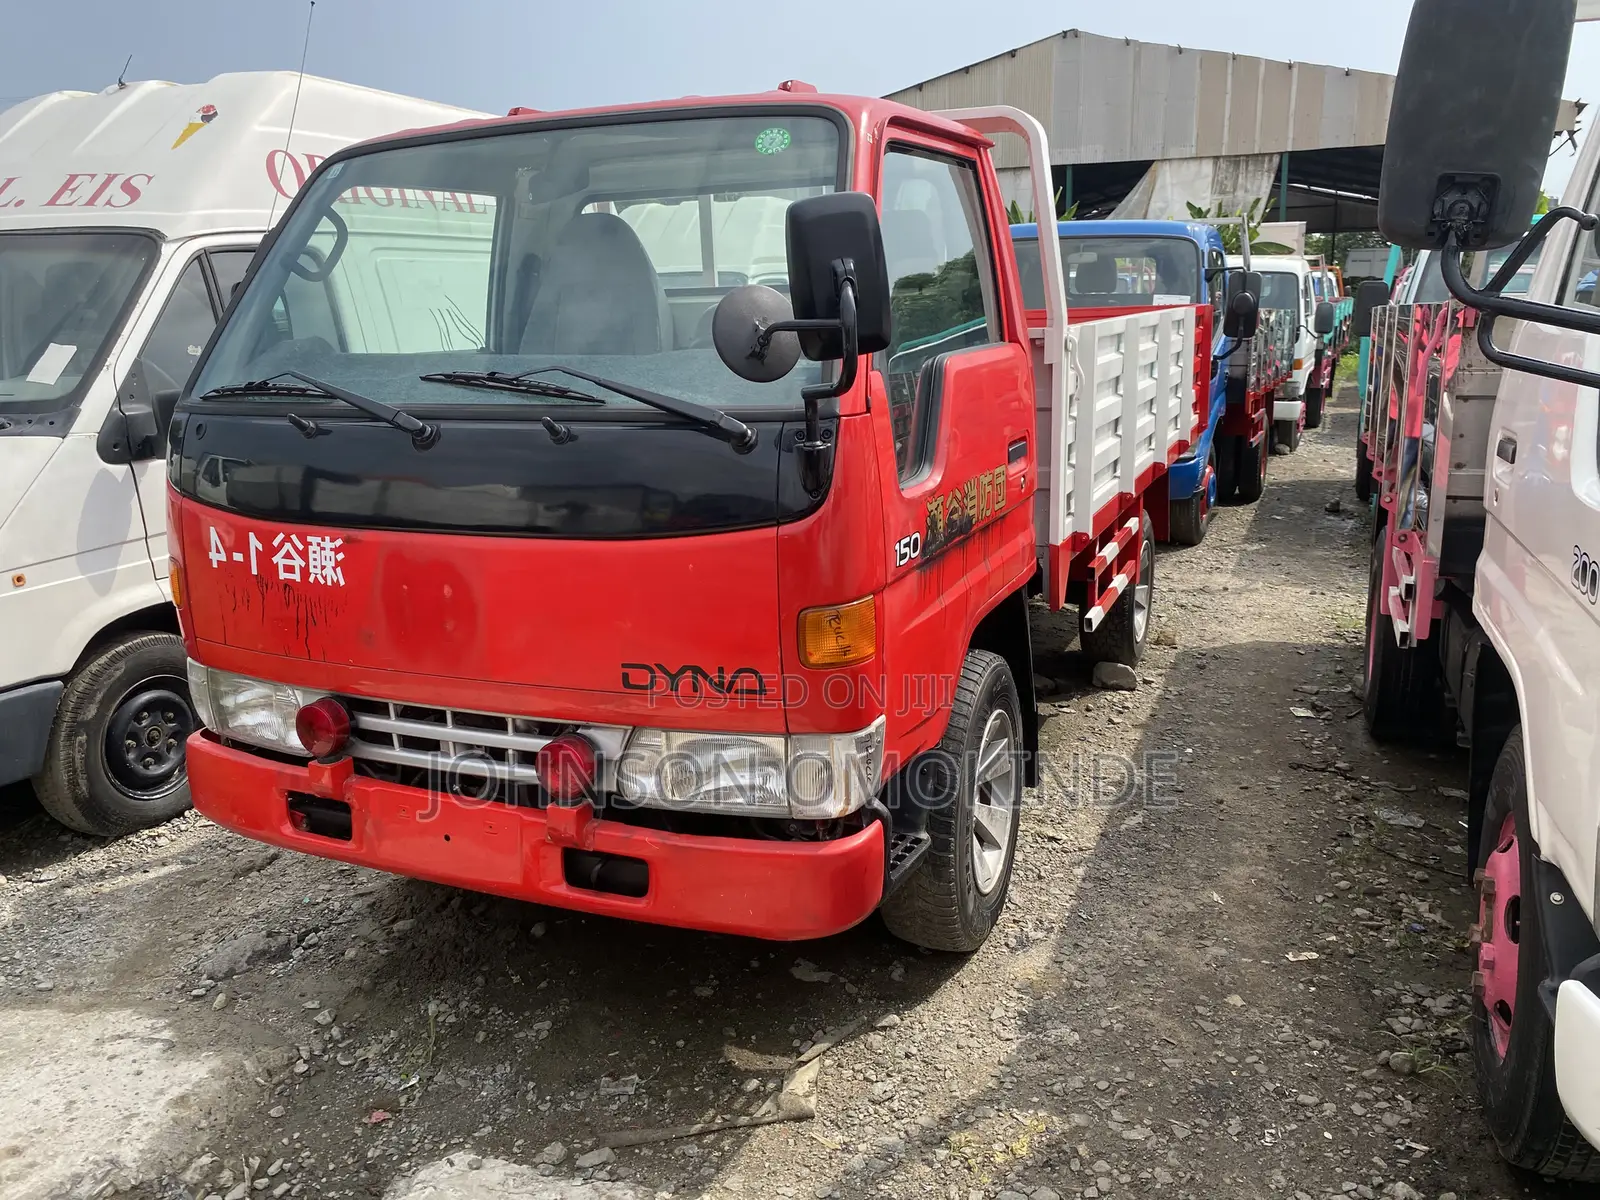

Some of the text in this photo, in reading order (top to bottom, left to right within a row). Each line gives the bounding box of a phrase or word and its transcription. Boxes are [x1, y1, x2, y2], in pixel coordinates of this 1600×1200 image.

[39, 173, 156, 208] EIS
[894, 532, 921, 568] 150
[1570, 544, 1600, 605] 200
[621, 662, 768, 696] DYNA
